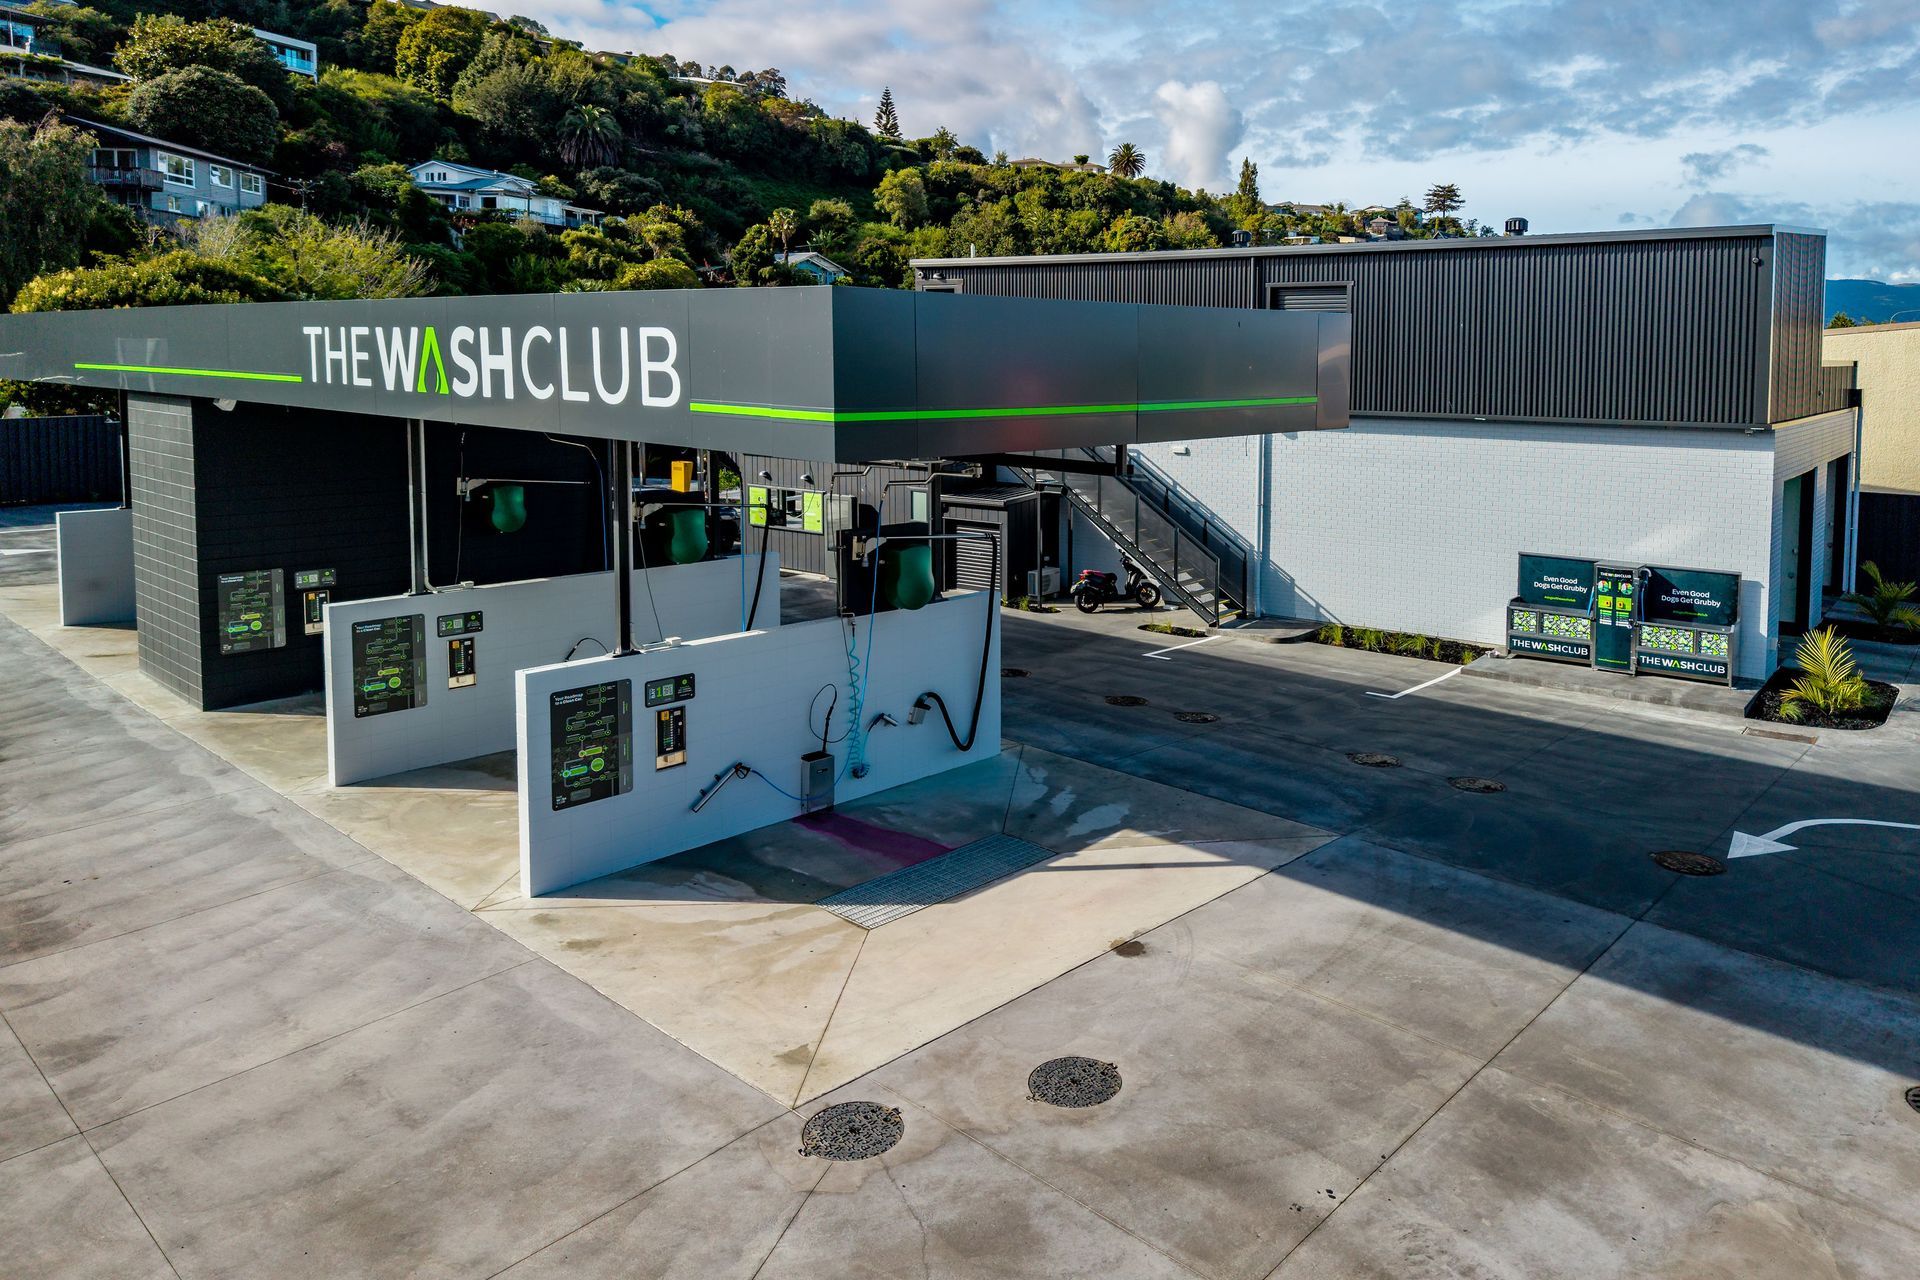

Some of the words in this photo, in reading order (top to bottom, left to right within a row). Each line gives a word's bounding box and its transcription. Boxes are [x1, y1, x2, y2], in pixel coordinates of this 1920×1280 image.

[1560, 577, 1578, 585] Good
[1533, 581, 1550, 589] Dogs
[1563, 584, 1588, 594] Grubby
[1690, 590, 1710, 598] Good
[1661, 595, 1679, 603] Dogs
[1694, 598, 1721, 608] Grubby
[446, 620, 453, 629] 2
[656, 687, 662, 698] 1
